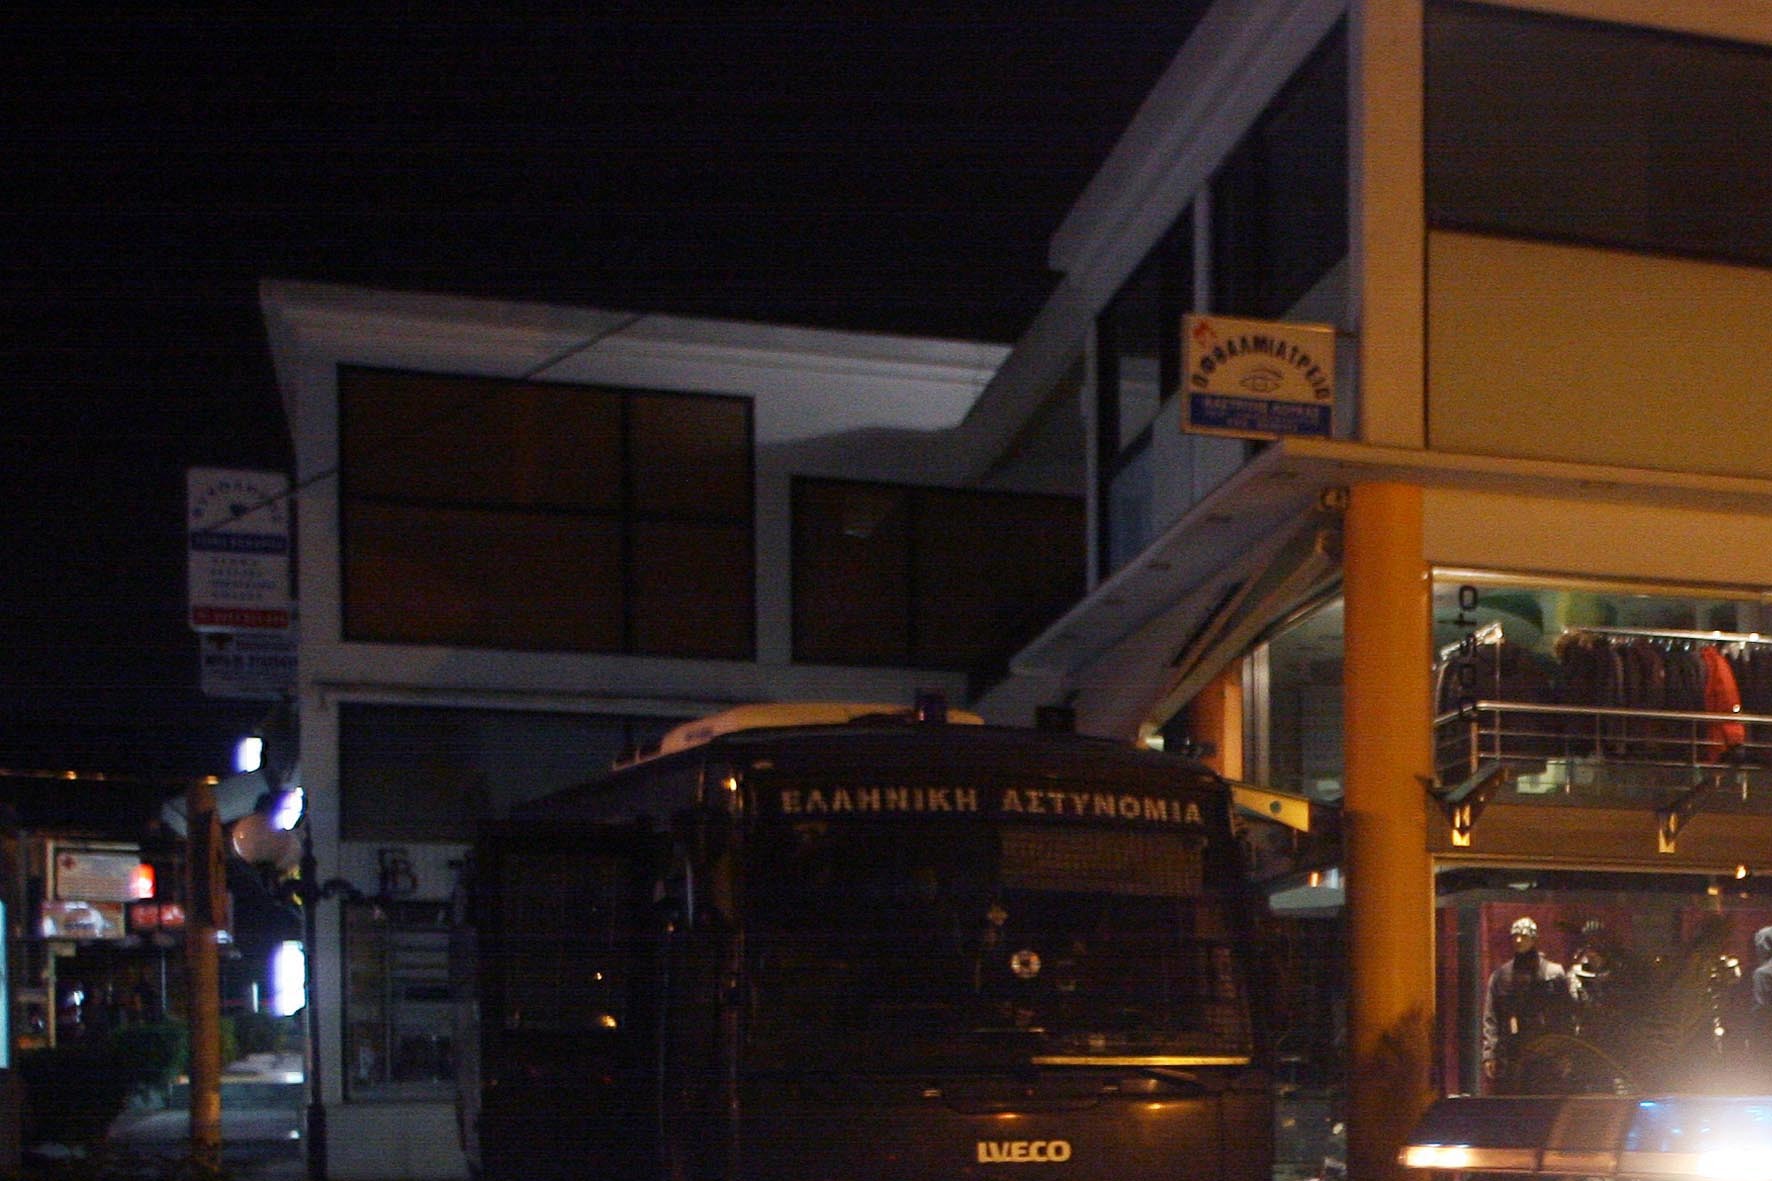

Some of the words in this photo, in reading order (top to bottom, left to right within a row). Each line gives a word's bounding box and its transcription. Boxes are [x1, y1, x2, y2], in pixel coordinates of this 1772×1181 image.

[780, 787, 979, 815] ΕΛΛΗΝΙΚΗ
[1001, 788, 1204, 825] ΑΣΤΥΝΟΜΙΑ
[977, 1139, 1073, 1164] IVECO
